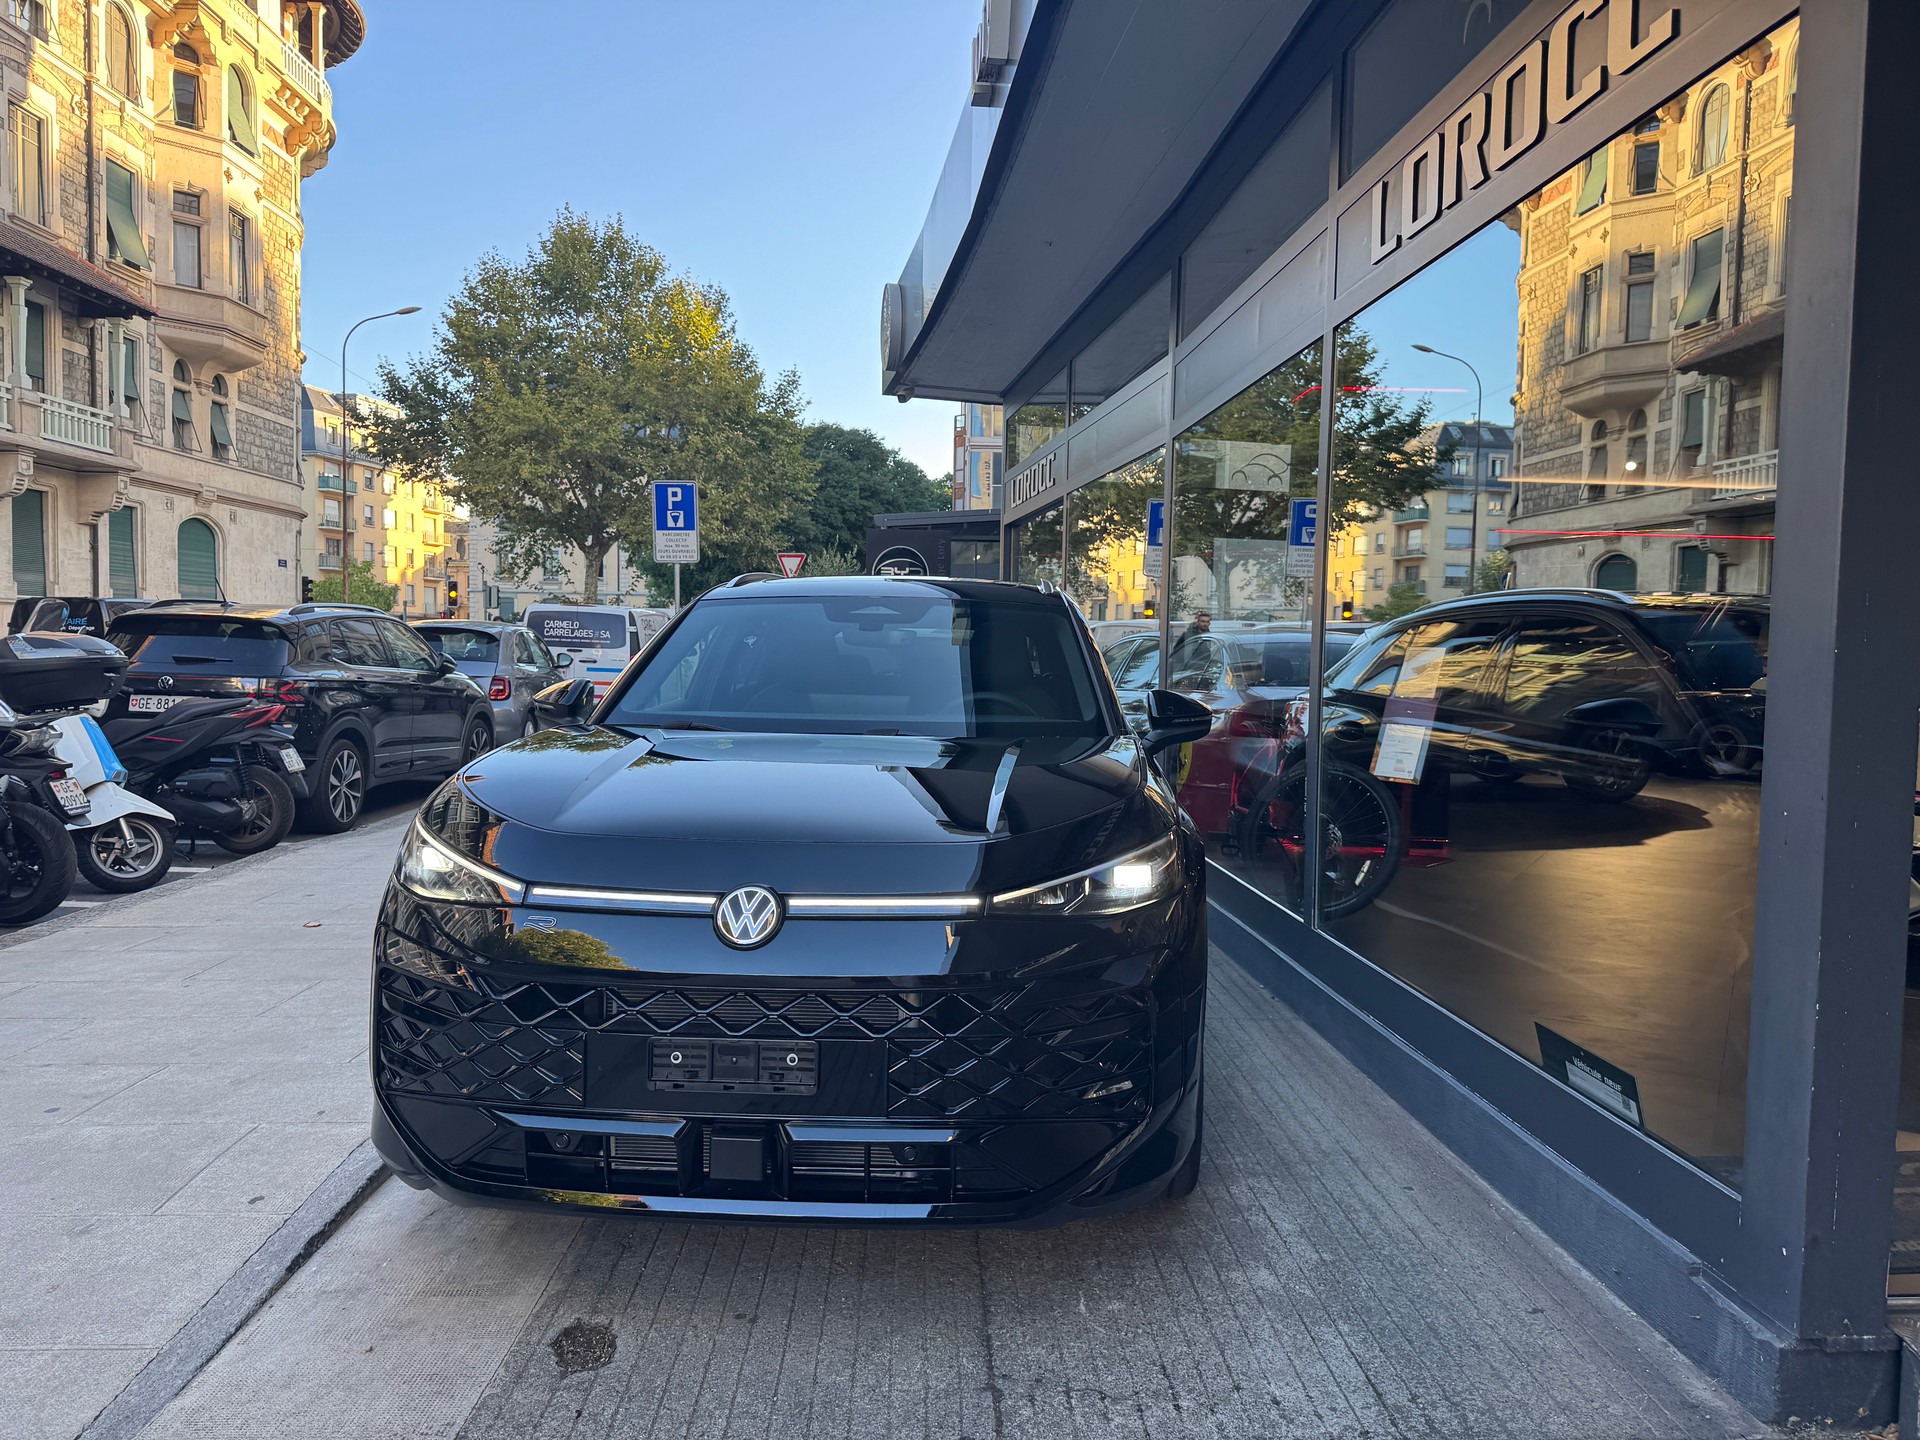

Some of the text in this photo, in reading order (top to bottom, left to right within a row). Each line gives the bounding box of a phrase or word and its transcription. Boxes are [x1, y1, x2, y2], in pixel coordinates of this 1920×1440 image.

[1010, 452, 1057, 510] LOROCC
[667, 487, 682, 510] P
[544, 620, 580, 629] CARMELO
[543, 628, 611, 639] CARRELAGES SA
